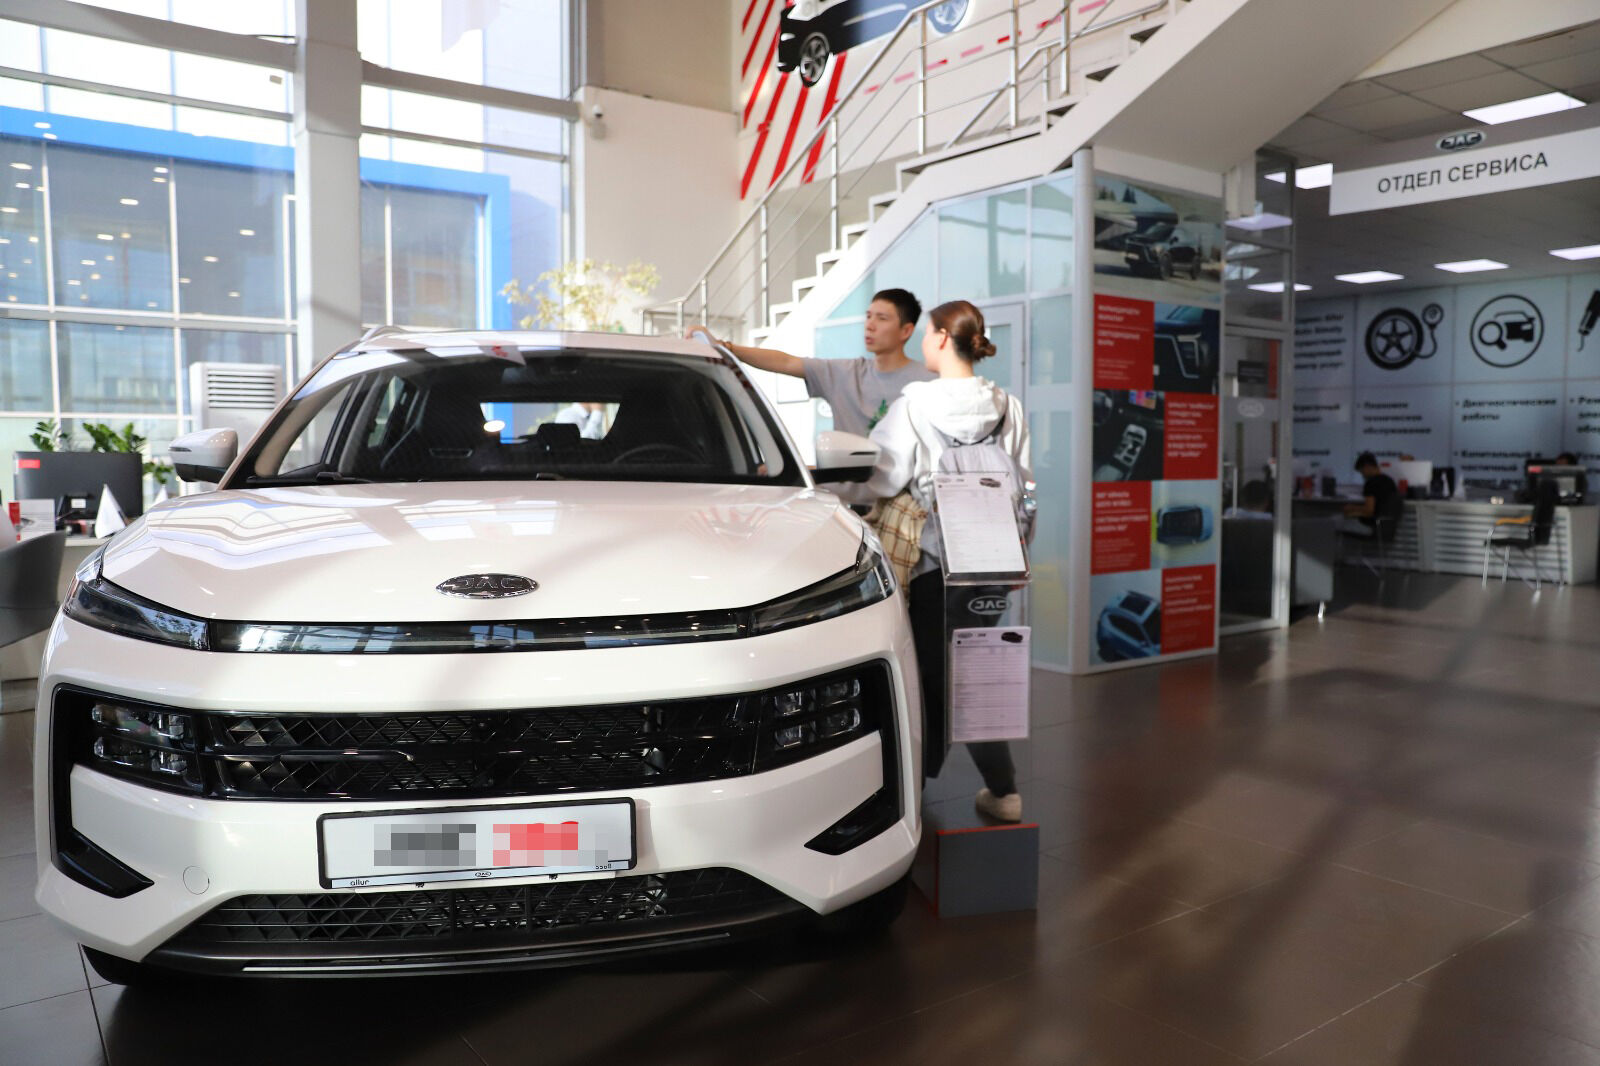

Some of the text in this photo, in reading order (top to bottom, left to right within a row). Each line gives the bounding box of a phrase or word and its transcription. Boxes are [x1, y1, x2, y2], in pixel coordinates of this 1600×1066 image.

[1442, 133, 1483, 149] JAC
[1377, 152, 1549, 194] ОТДЕЛ СЕРВИСА
[974, 600, 1007, 610] JAC
